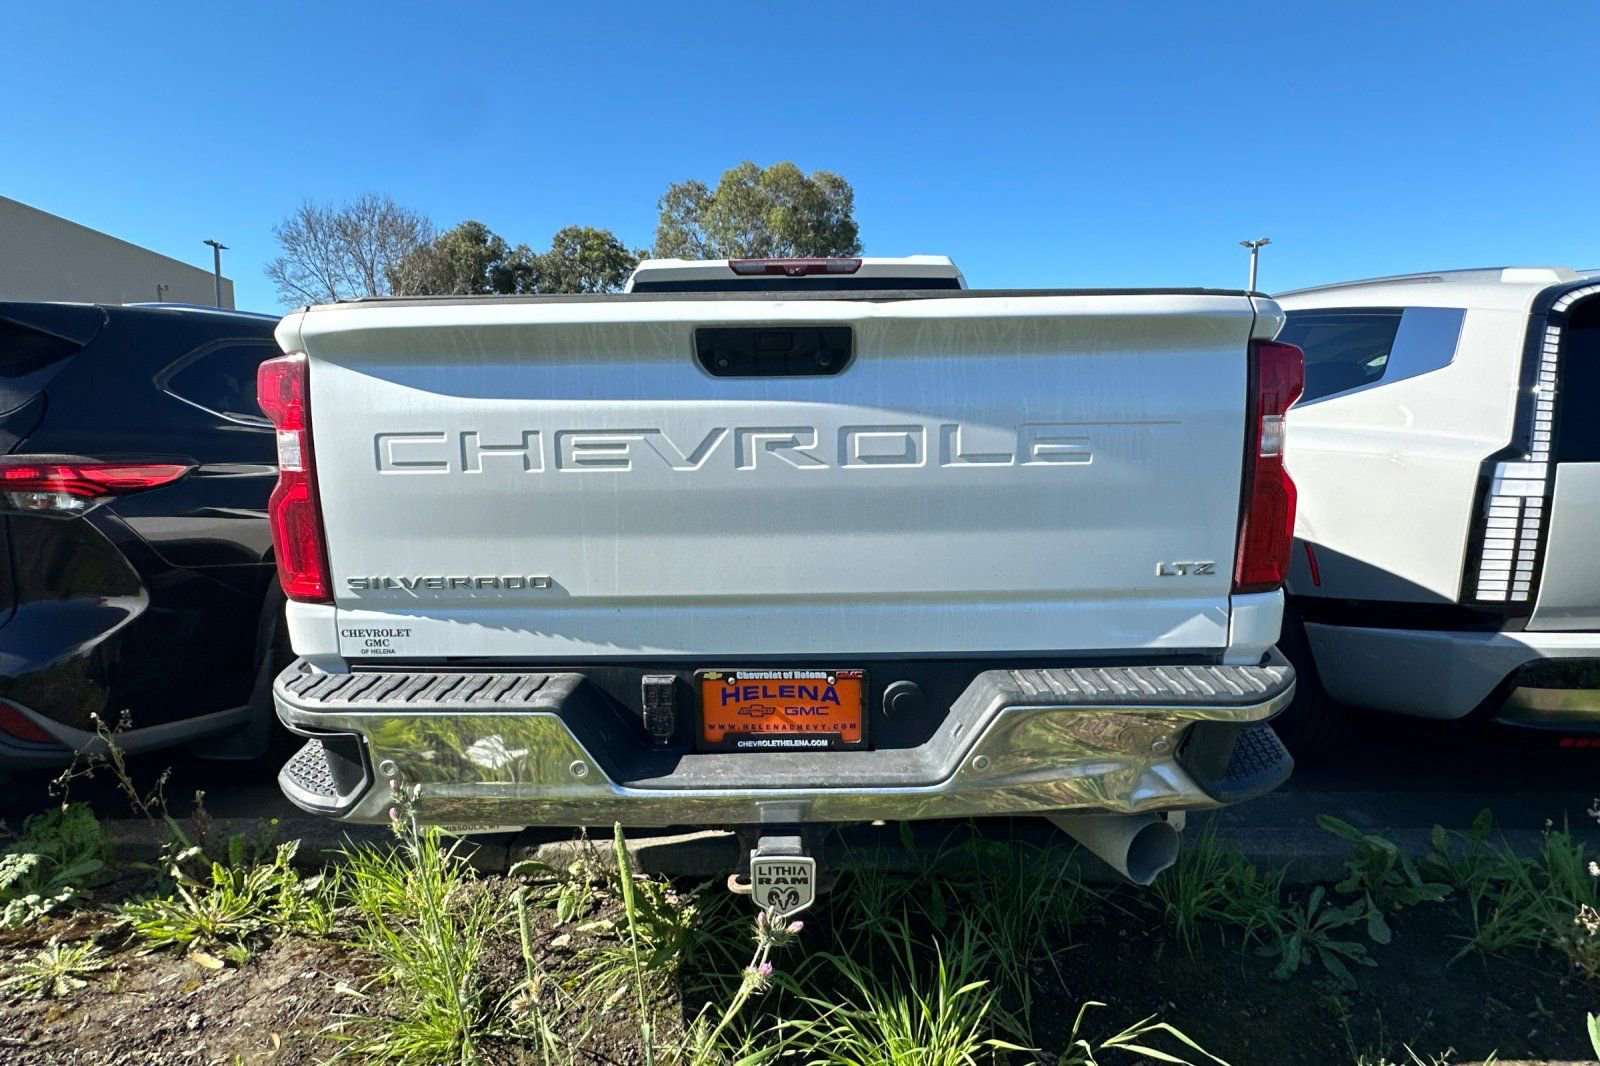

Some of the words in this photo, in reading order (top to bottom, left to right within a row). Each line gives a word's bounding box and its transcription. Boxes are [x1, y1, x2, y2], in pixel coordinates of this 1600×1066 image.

[1155, 560, 1217, 577] LTZ
[346, 574, 553, 591] SILVERADO
[341, 628, 411, 638] CHEVROLET
[364, 638, 390, 648] GMC
[736, 671, 782, 680] Chevrolet
[783, 671, 793, 679] of
[794, 671, 827, 679] Helena
[721, 685, 841, 706] HELENA
[784, 706, 829, 716] GMC
[708, 722, 857, 731] WWW.HELENACHEVY.COM
[737, 739, 828, 748] CHEVROLETHELENA.COM
[758, 866, 807, 876] LITHIA
[758, 877, 808, 885] RAM
